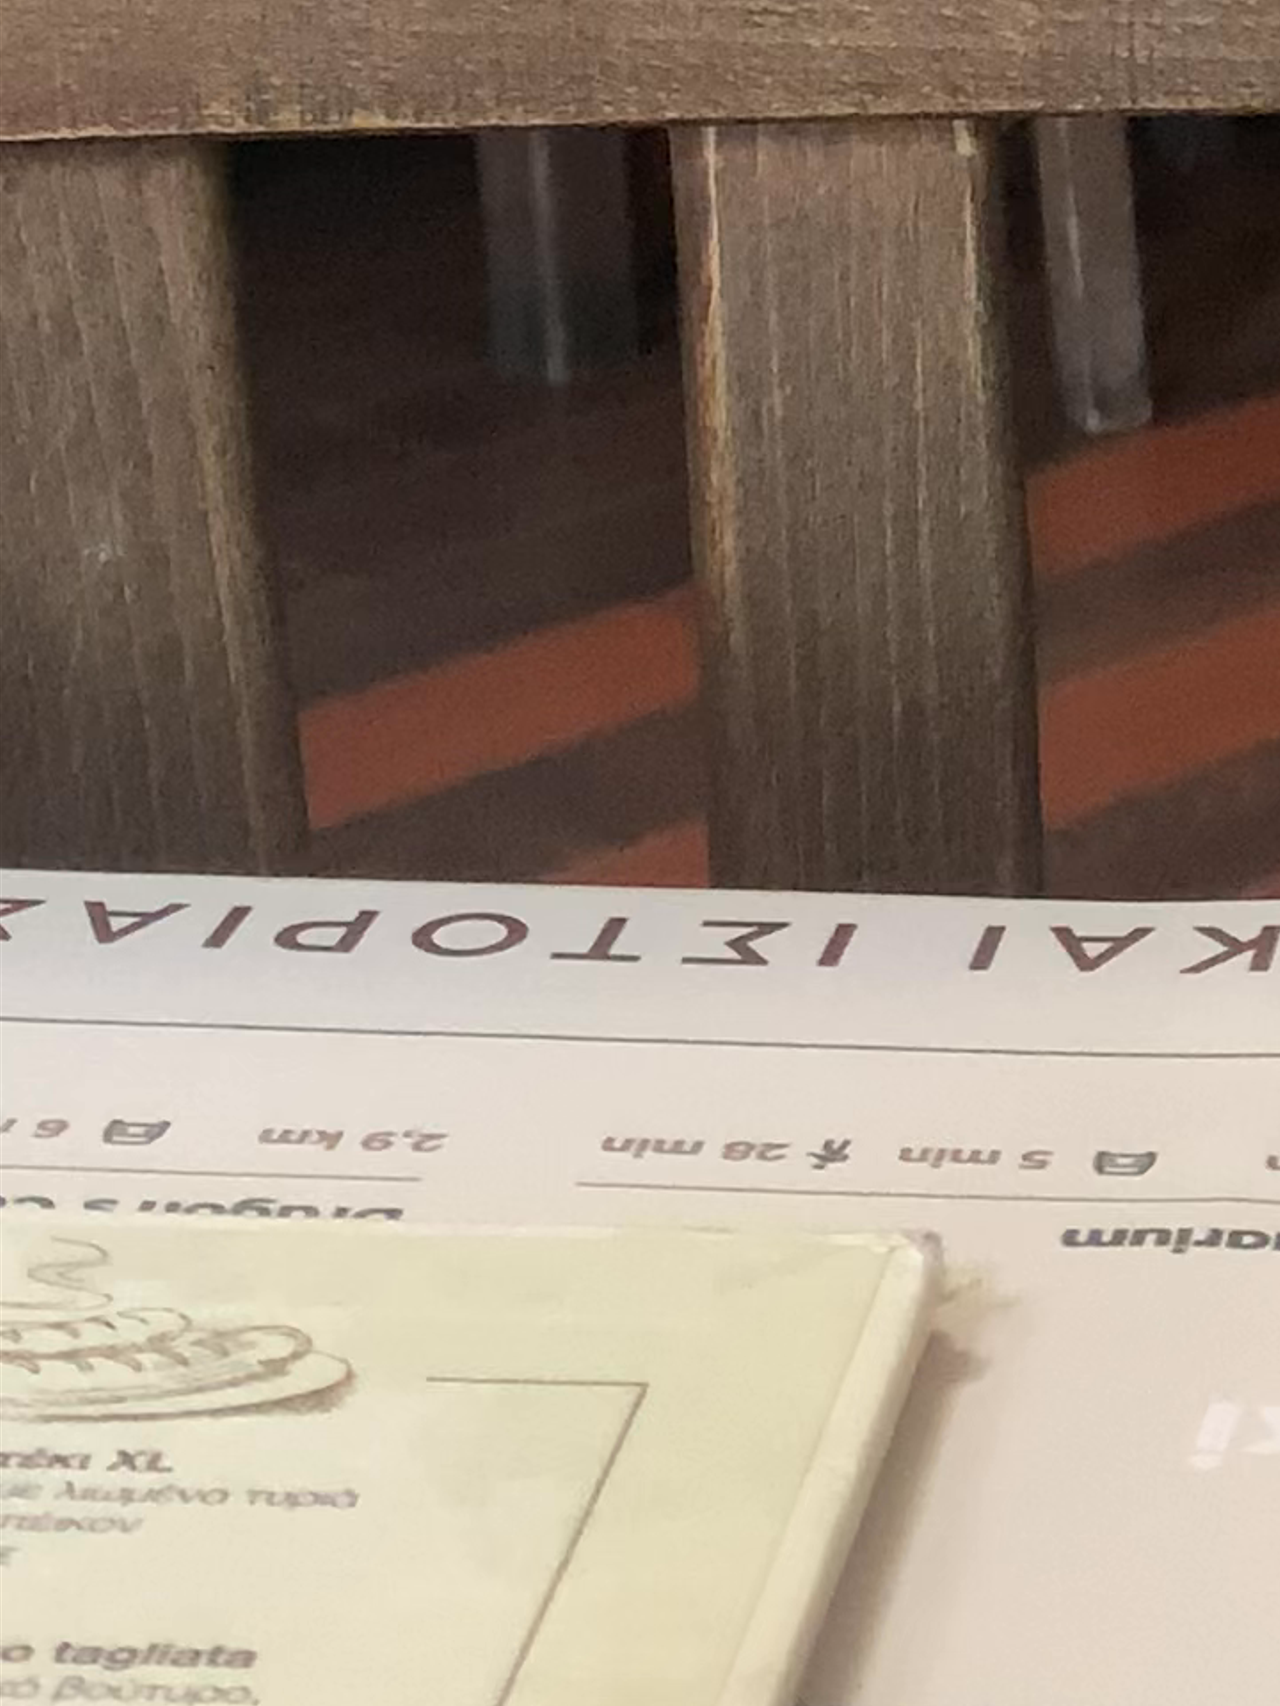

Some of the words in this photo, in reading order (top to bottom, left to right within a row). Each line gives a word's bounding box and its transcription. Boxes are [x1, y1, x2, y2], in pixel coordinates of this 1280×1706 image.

[257, 1127, 345, 1152] km
[600, 1135, 706, 1160] min
[720, 1140, 792, 1163] 28
[897, 1146, 1003, 1170] min
[1017, 1149, 1055, 1171] 5
[53, 1641, 259, 1672] tagliata
